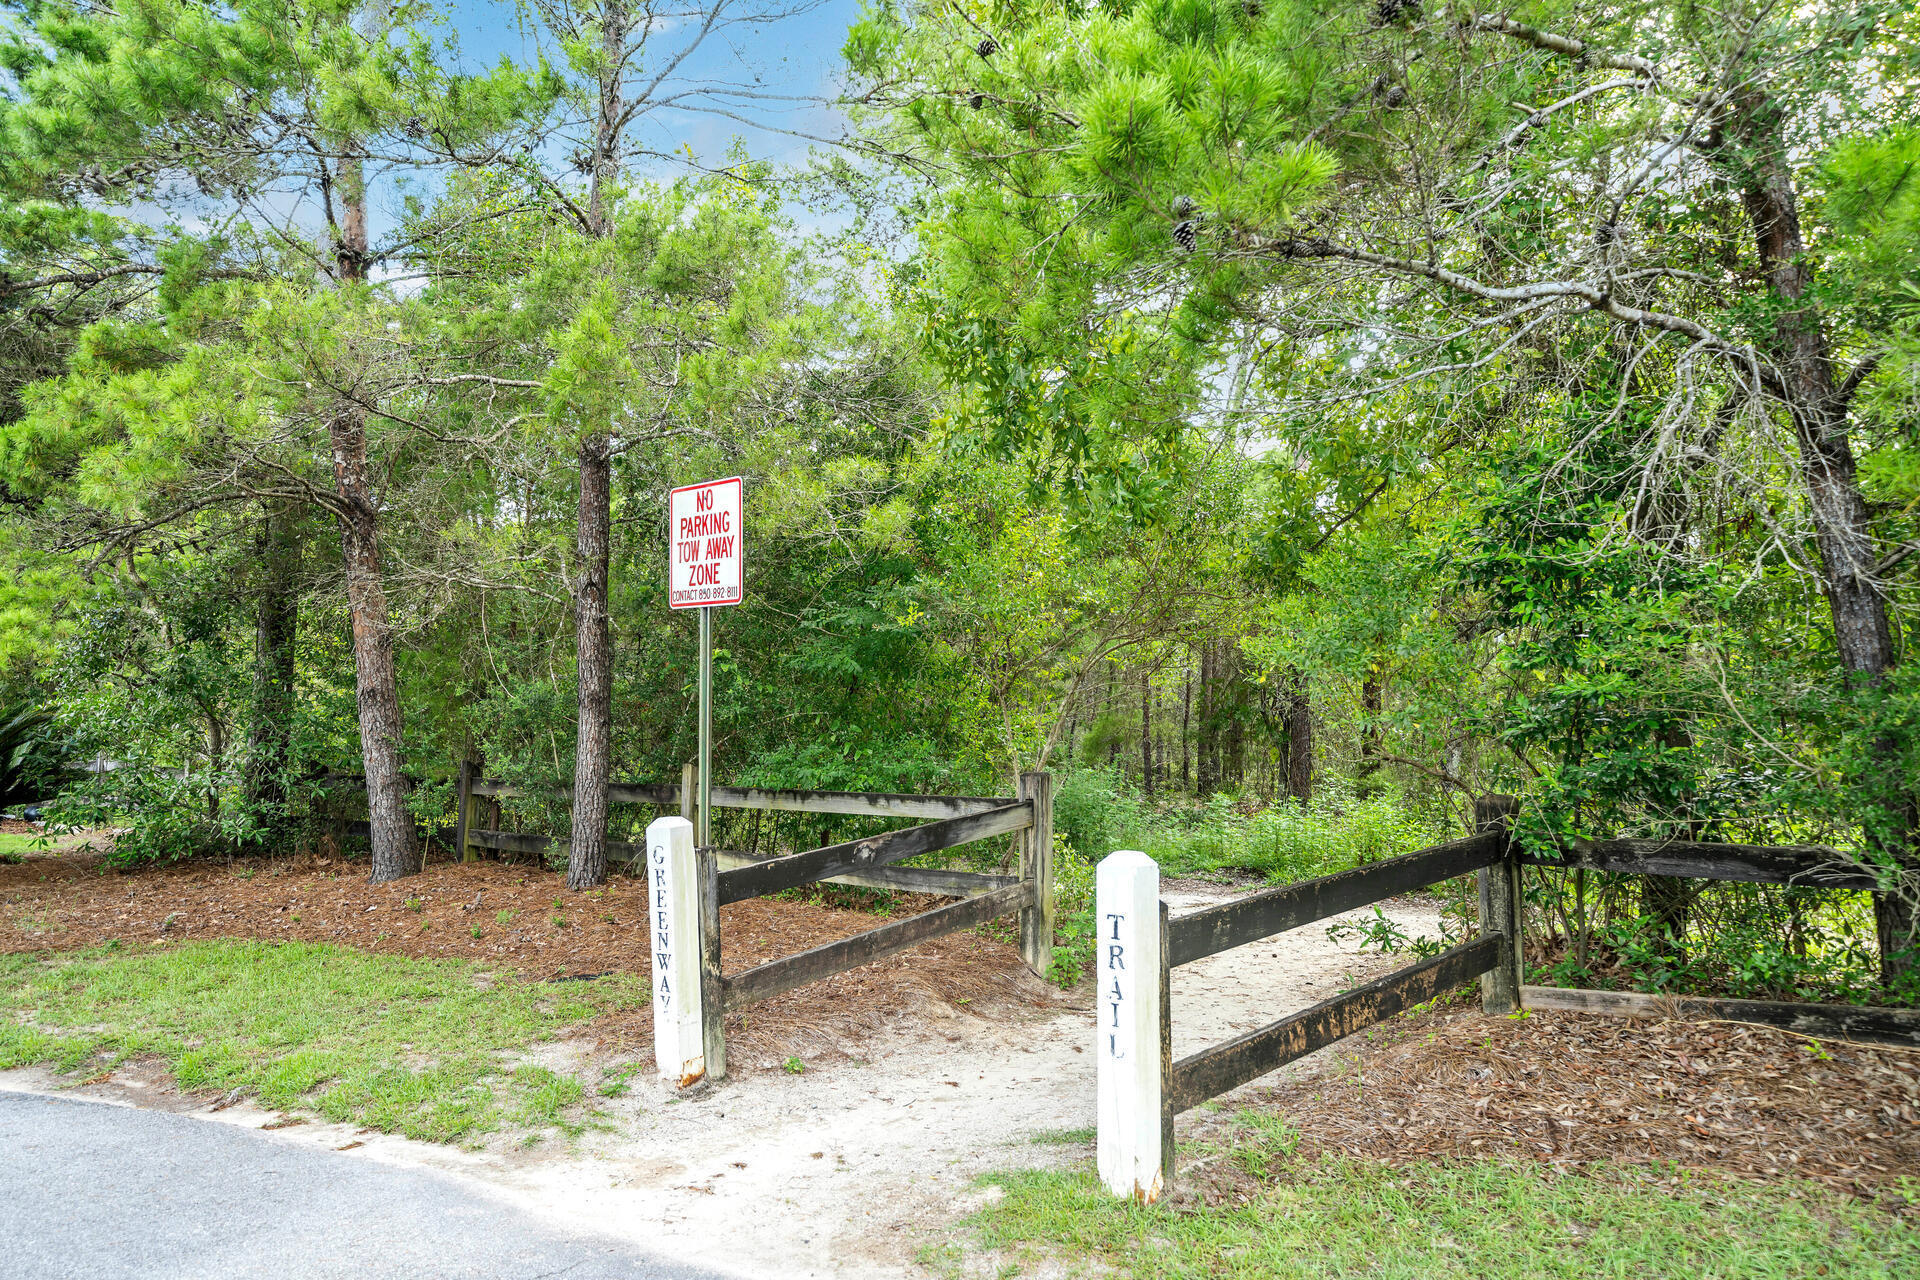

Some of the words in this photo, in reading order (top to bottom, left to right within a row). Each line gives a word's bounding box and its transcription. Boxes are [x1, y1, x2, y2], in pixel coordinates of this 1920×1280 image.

[696, 489, 713, 512] NO
[680, 511, 730, 539] PARKING
[677, 540, 700, 563] TOW
[705, 535, 735, 560] AWAY
[688, 562, 721, 586] ZONE
[672, 589, 698, 602] CONTACT
[1106, 913, 1125, 1059] TRAIL
